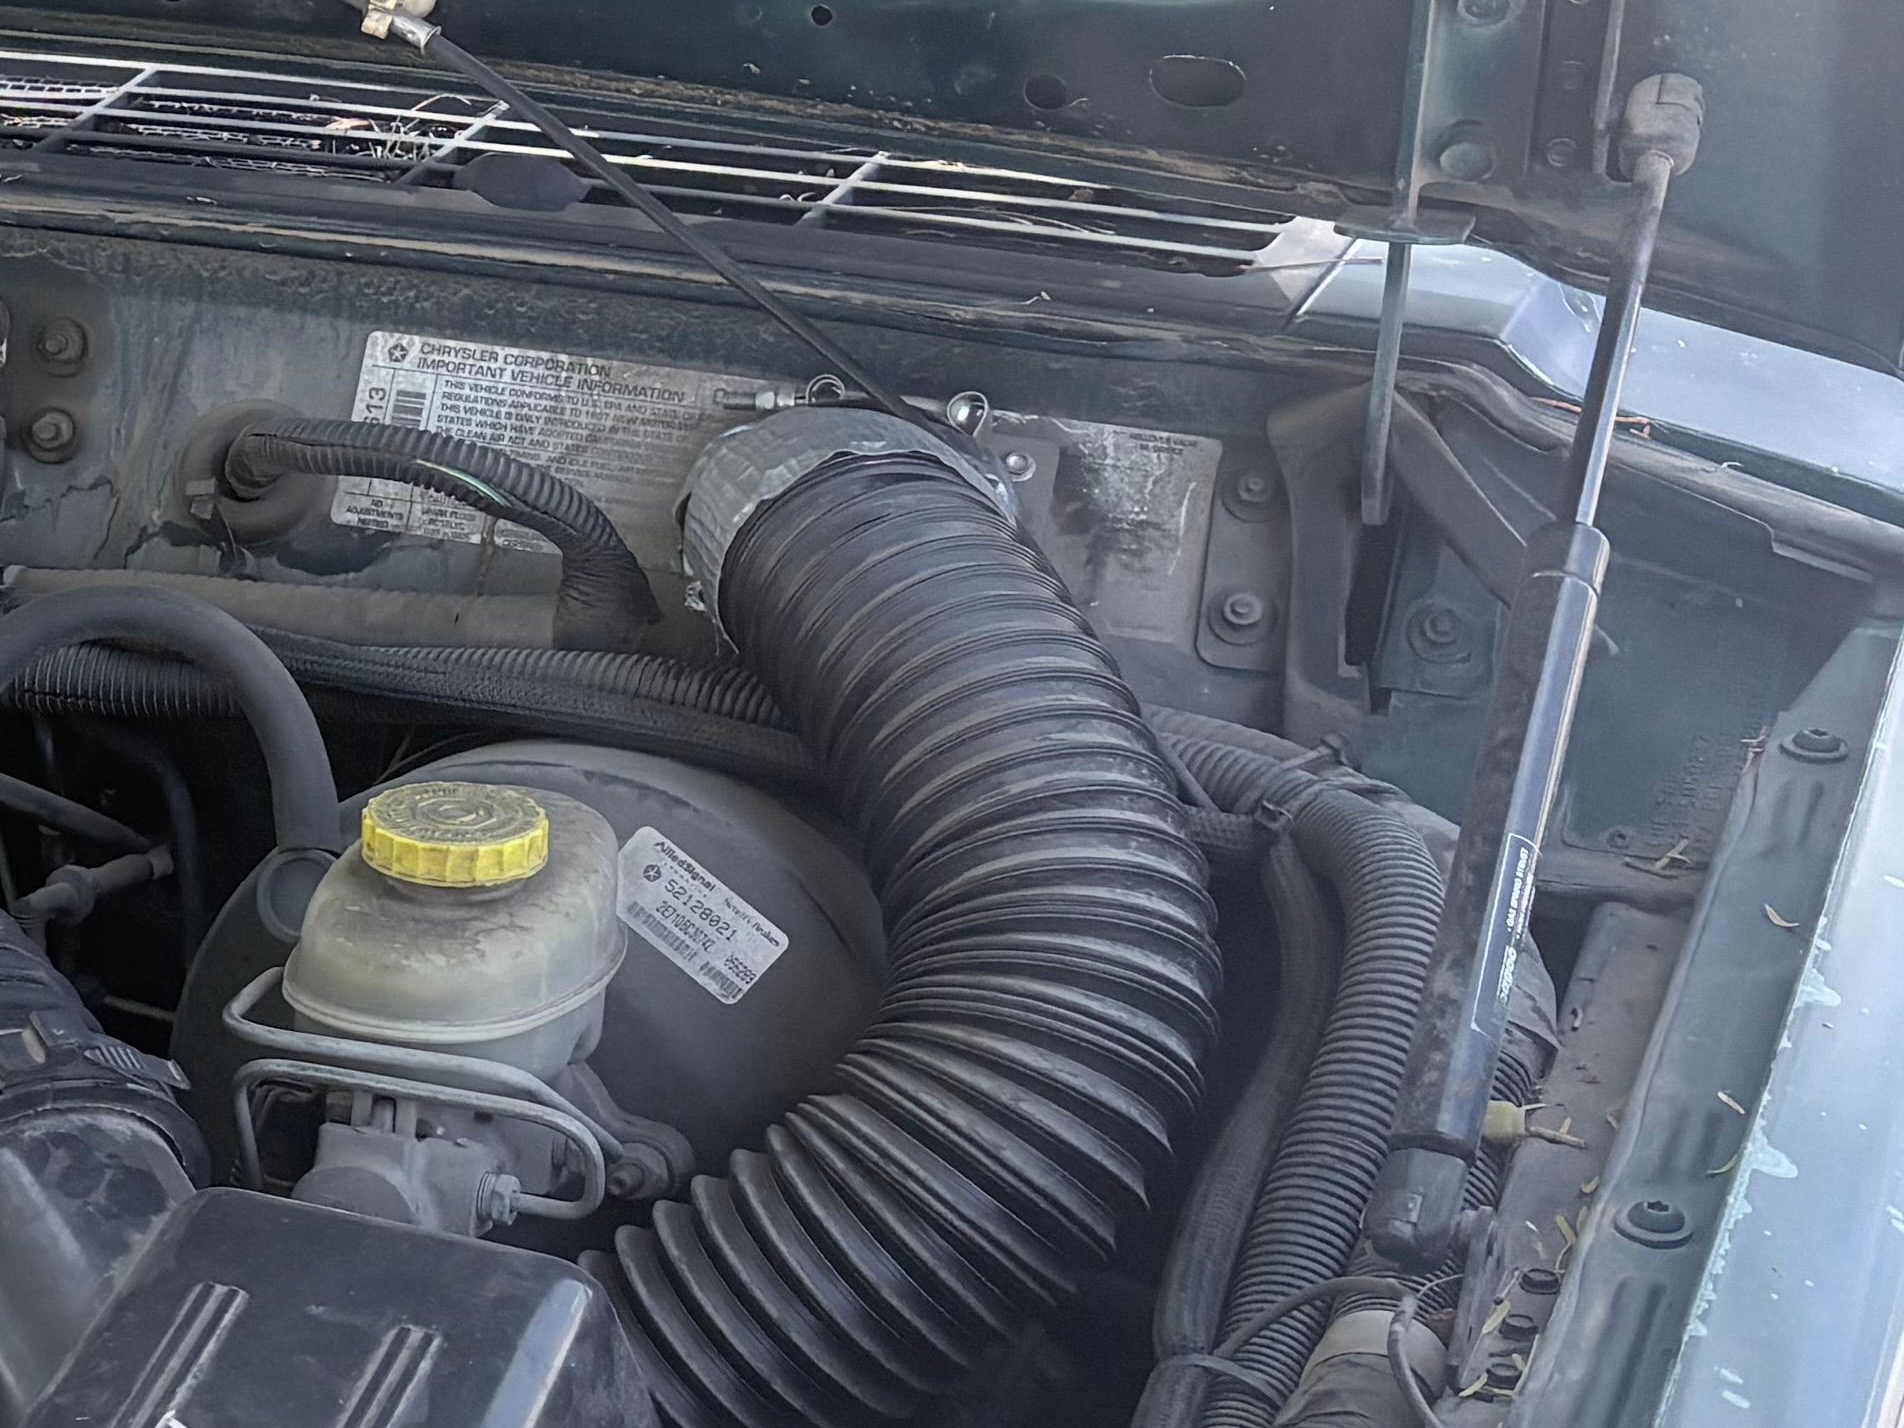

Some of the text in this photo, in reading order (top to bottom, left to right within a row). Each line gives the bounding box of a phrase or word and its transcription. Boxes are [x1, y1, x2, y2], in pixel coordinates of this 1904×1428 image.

[420, 342, 612, 378] CHRYSLER CORPORATION
[416, 357, 685, 402] IMPORTANT VEHICLE INFORMATION
[445, 380, 467, 390] THIS
[468, 383, 506, 396] VEHICLE
[509, 388, 563, 402] CONFORMS
[441, 403, 461, 414] THIS
[463, 406, 502, 419] VEHICLE
[442, 392, 507, 408] REGULATIONS
[475, 419, 508, 432] WHICH
[654, 841, 716, 892] AlliedSignal
[664, 879, 737, 941] 52128021
